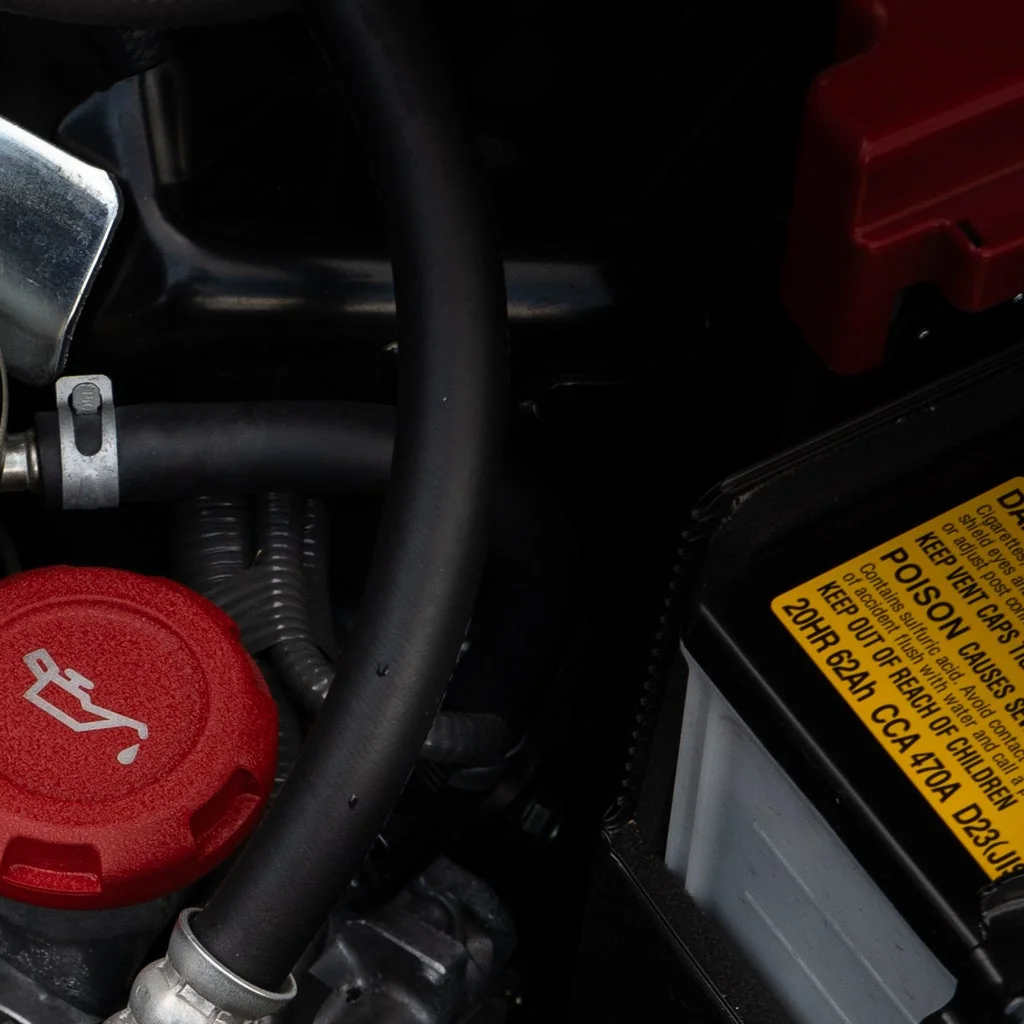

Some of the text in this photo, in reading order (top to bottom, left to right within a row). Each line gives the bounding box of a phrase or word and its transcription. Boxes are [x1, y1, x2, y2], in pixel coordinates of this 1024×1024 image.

[915, 531, 1019, 643] KEEP VENT CAPS
[942, 522, 960, 535] or
[953, 536, 990, 571] adjust
[980, 571, 1011, 597] post
[958, 514, 994, 548] shield
[988, 548, 1016, 575] eyes
[817, 580, 1018, 811] KEEP OUT OF REACH OF CHILDREN
[842, 572, 862, 586] of
[855, 587, 900, 634] accident
[894, 634, 924, 665] flush
[920, 664, 948, 693] with
[944, 692, 977, 727] water
[972, 730, 1000, 752] and
[992, 753, 1019, 775] call
[859, 562, 905, 612] Contains
[899, 612, 941, 656] sulfuric
[959, 685, 996, 719] Avoid
[879, 546, 970, 640] POISON
[958, 641, 1015, 699] CAUSES
[782, 598, 840, 653] 20HR
[826, 649, 877, 702] 62Ah
[871, 704, 920, 754] CCA
[910, 751, 961, 803] 470A
